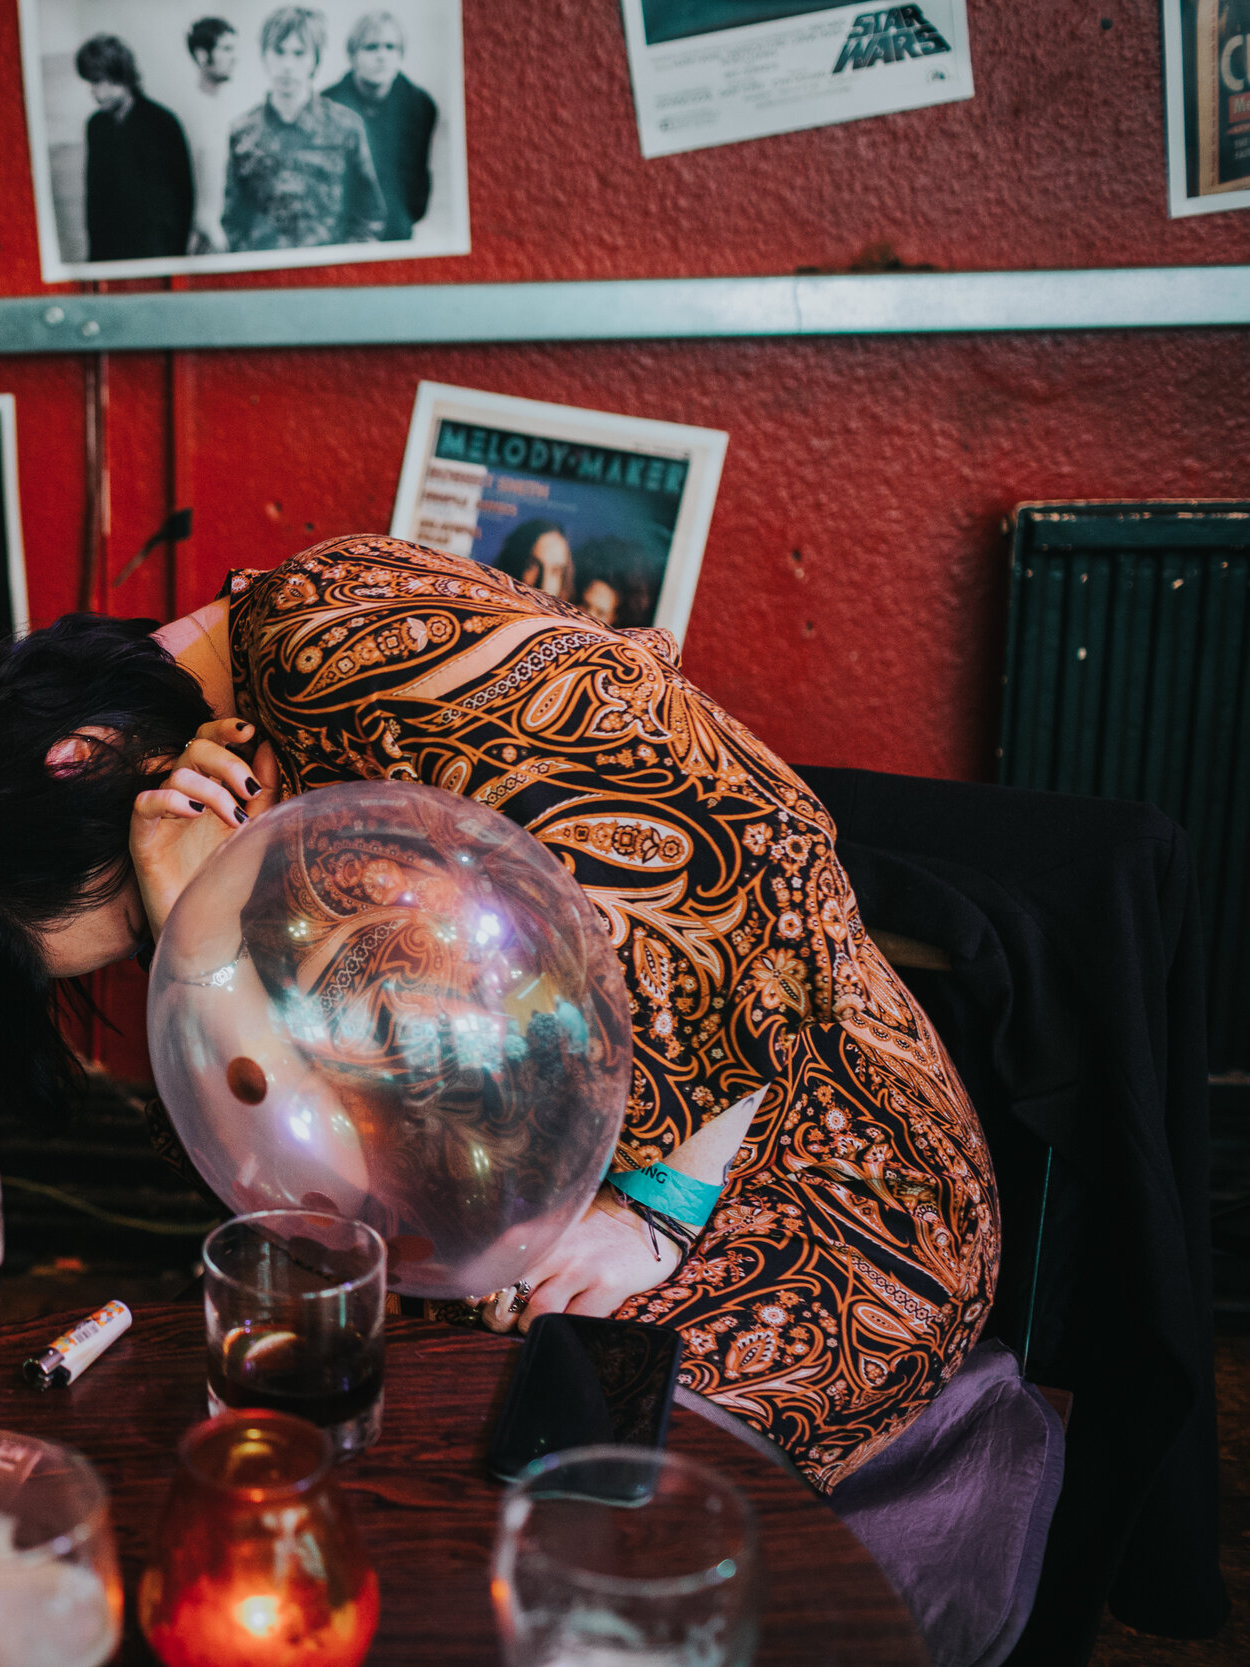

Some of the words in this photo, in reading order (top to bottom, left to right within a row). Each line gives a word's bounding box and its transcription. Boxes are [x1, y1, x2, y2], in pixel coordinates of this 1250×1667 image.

[846, 2, 934, 41] STAR
[831, 23, 952, 75] WARS
[439, 424, 570, 474] MELODY
[578, 451, 685, 495] MAKER
